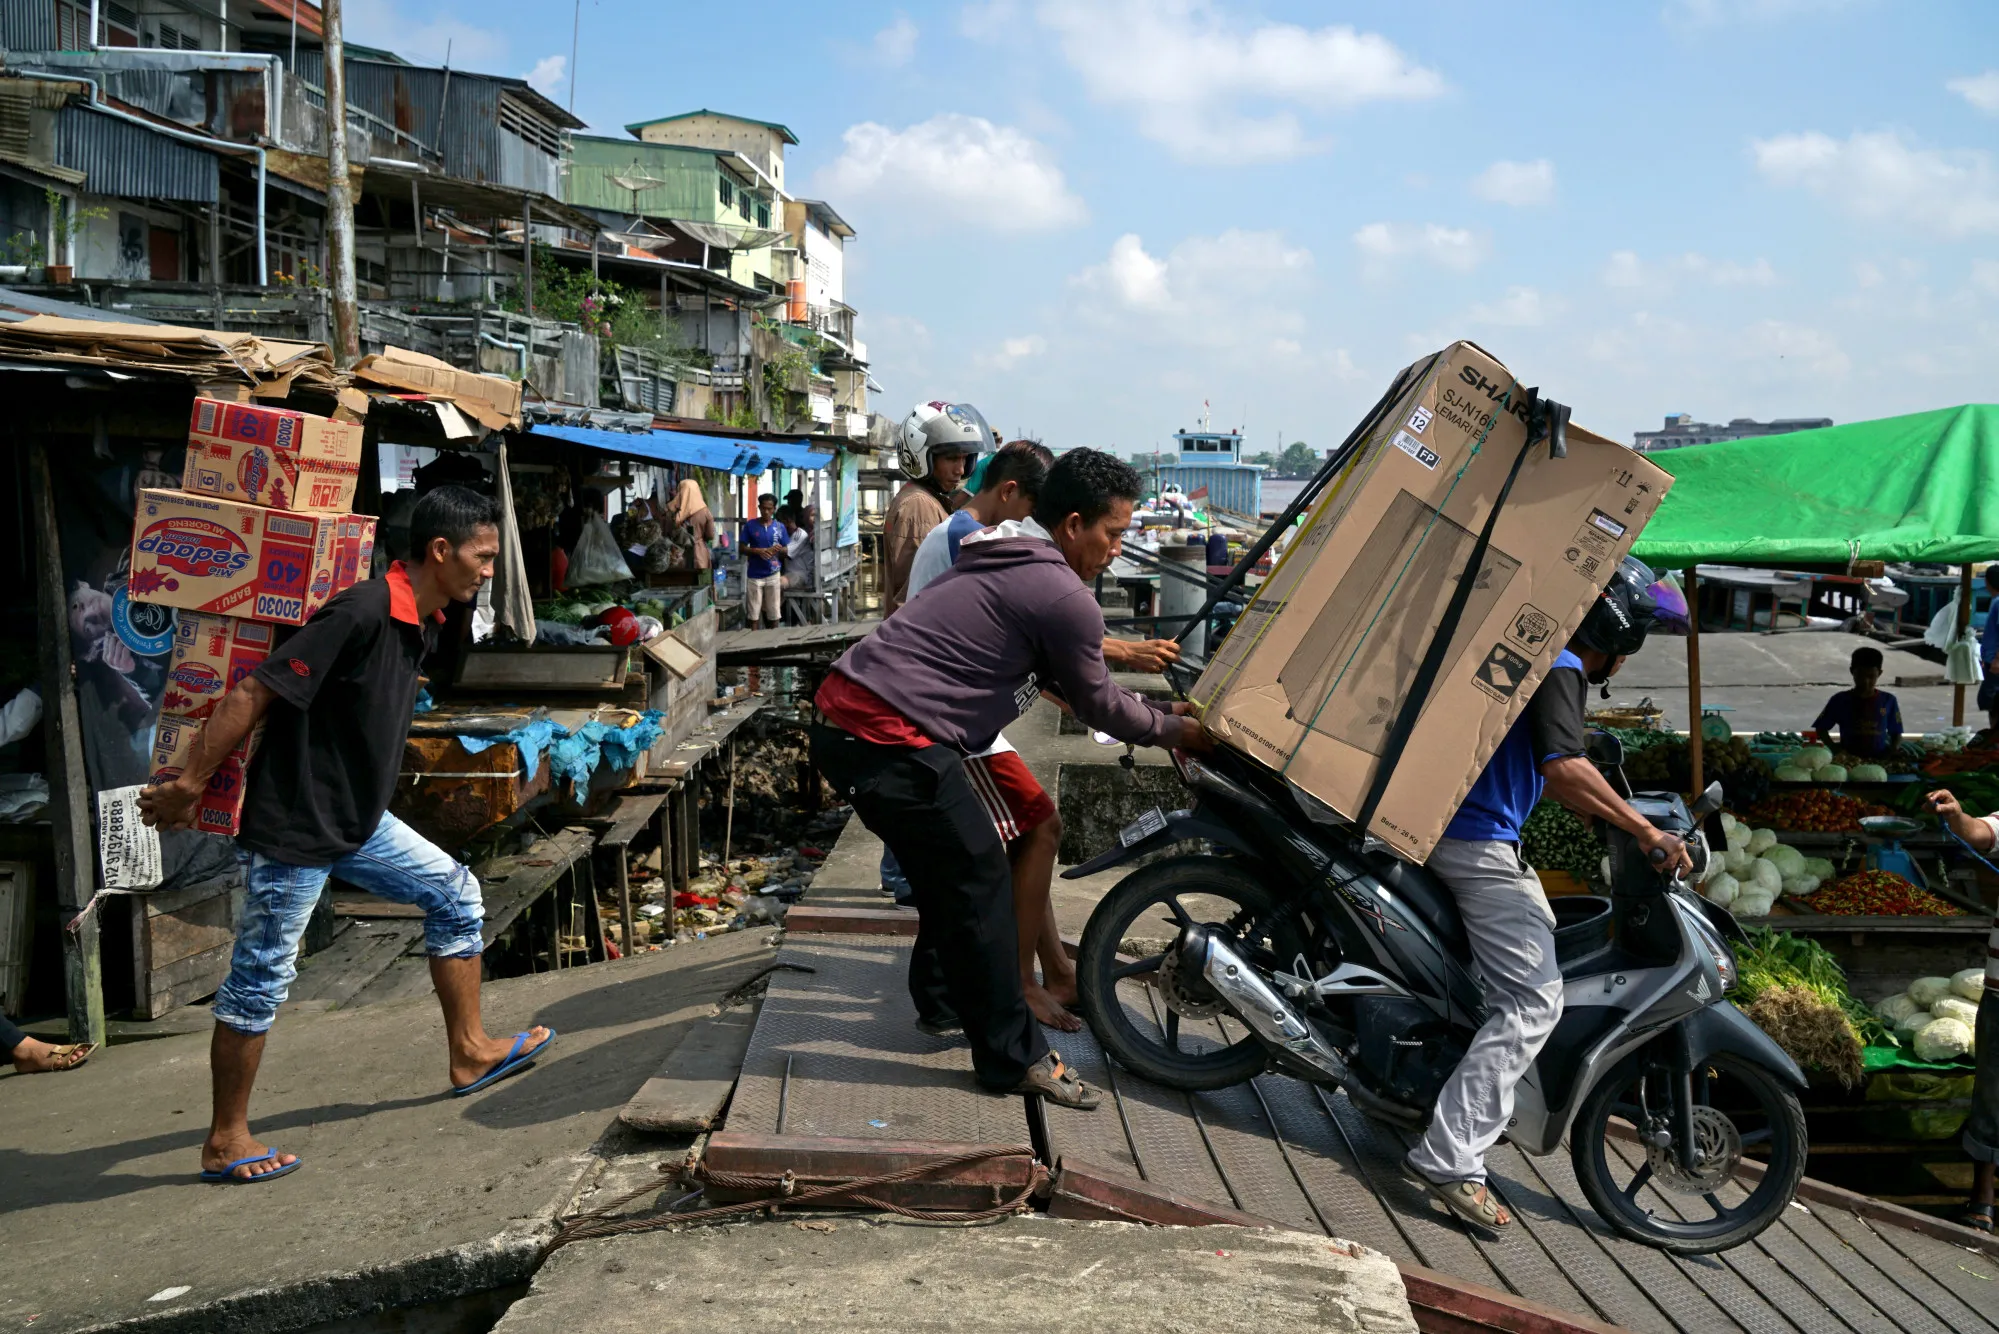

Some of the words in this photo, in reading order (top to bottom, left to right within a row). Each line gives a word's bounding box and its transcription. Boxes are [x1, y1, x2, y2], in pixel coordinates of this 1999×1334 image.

[1458, 365, 1530, 422] SHAR
[240, 413, 259, 438] 40
[1410, 414, 1426, 430] 12
[1434, 402, 1472, 434] LEMARI
[276, 417, 295, 448] 20030
[1419, 450, 1434, 462] FP
[248, 446, 265, 503] Sedaap
[168, 520, 210, 533] GORENG
[213, 524, 226, 534] MI
[165, 534, 201, 545] Instant
[137, 534, 253, 570] Sedaap
[208, 566, 236, 578] Mie
[268, 560, 302, 584] 40
[1583, 557, 1600, 572] SNI
[225, 586, 252, 606] BARU
[257, 597, 302, 618] 20030
[1508, 654, 1524, 669] 100kg
[168, 670, 223, 690] Sedaap
[209, 771, 236, 792] 40
[204, 808, 232, 826] 20030
[1380, 816, 1397, 830] Berat
[1400, 829, 1410, 838] 26
[1410, 834, 1419, 845] Kg
[1685, 989, 1704, 1004] HONDA
